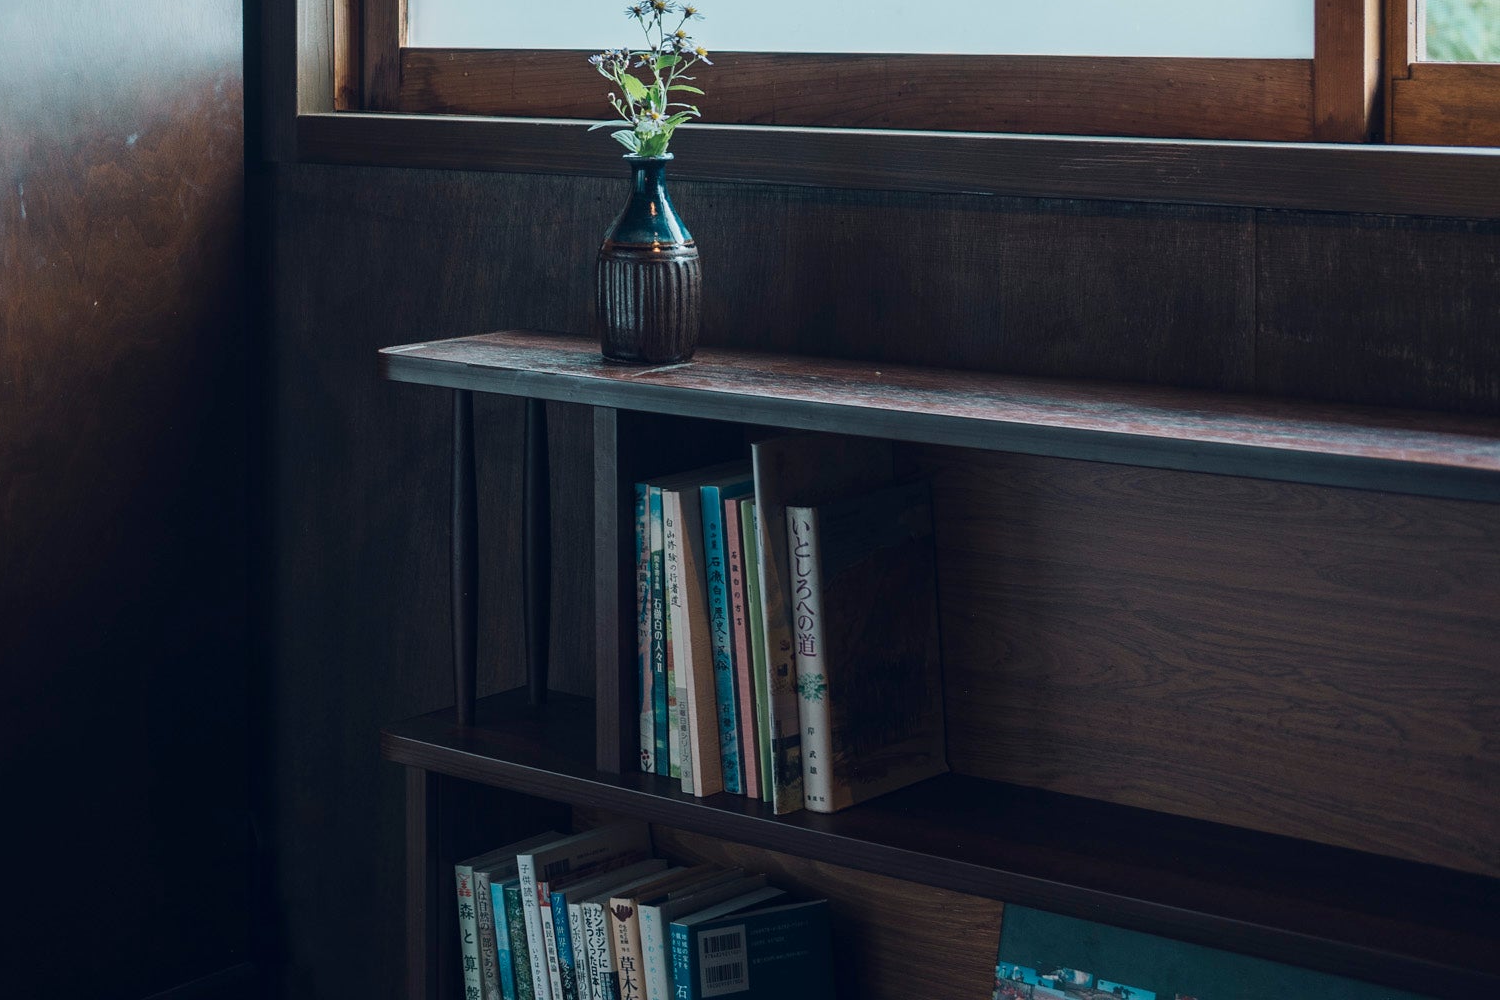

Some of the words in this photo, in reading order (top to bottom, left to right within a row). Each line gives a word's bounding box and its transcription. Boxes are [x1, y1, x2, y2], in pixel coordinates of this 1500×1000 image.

[792, 516, 817, 657] いとしろへの道
[584, 906, 601, 998] 村をつくった日本人
[593, 907, 608, 968] カンボジアに
